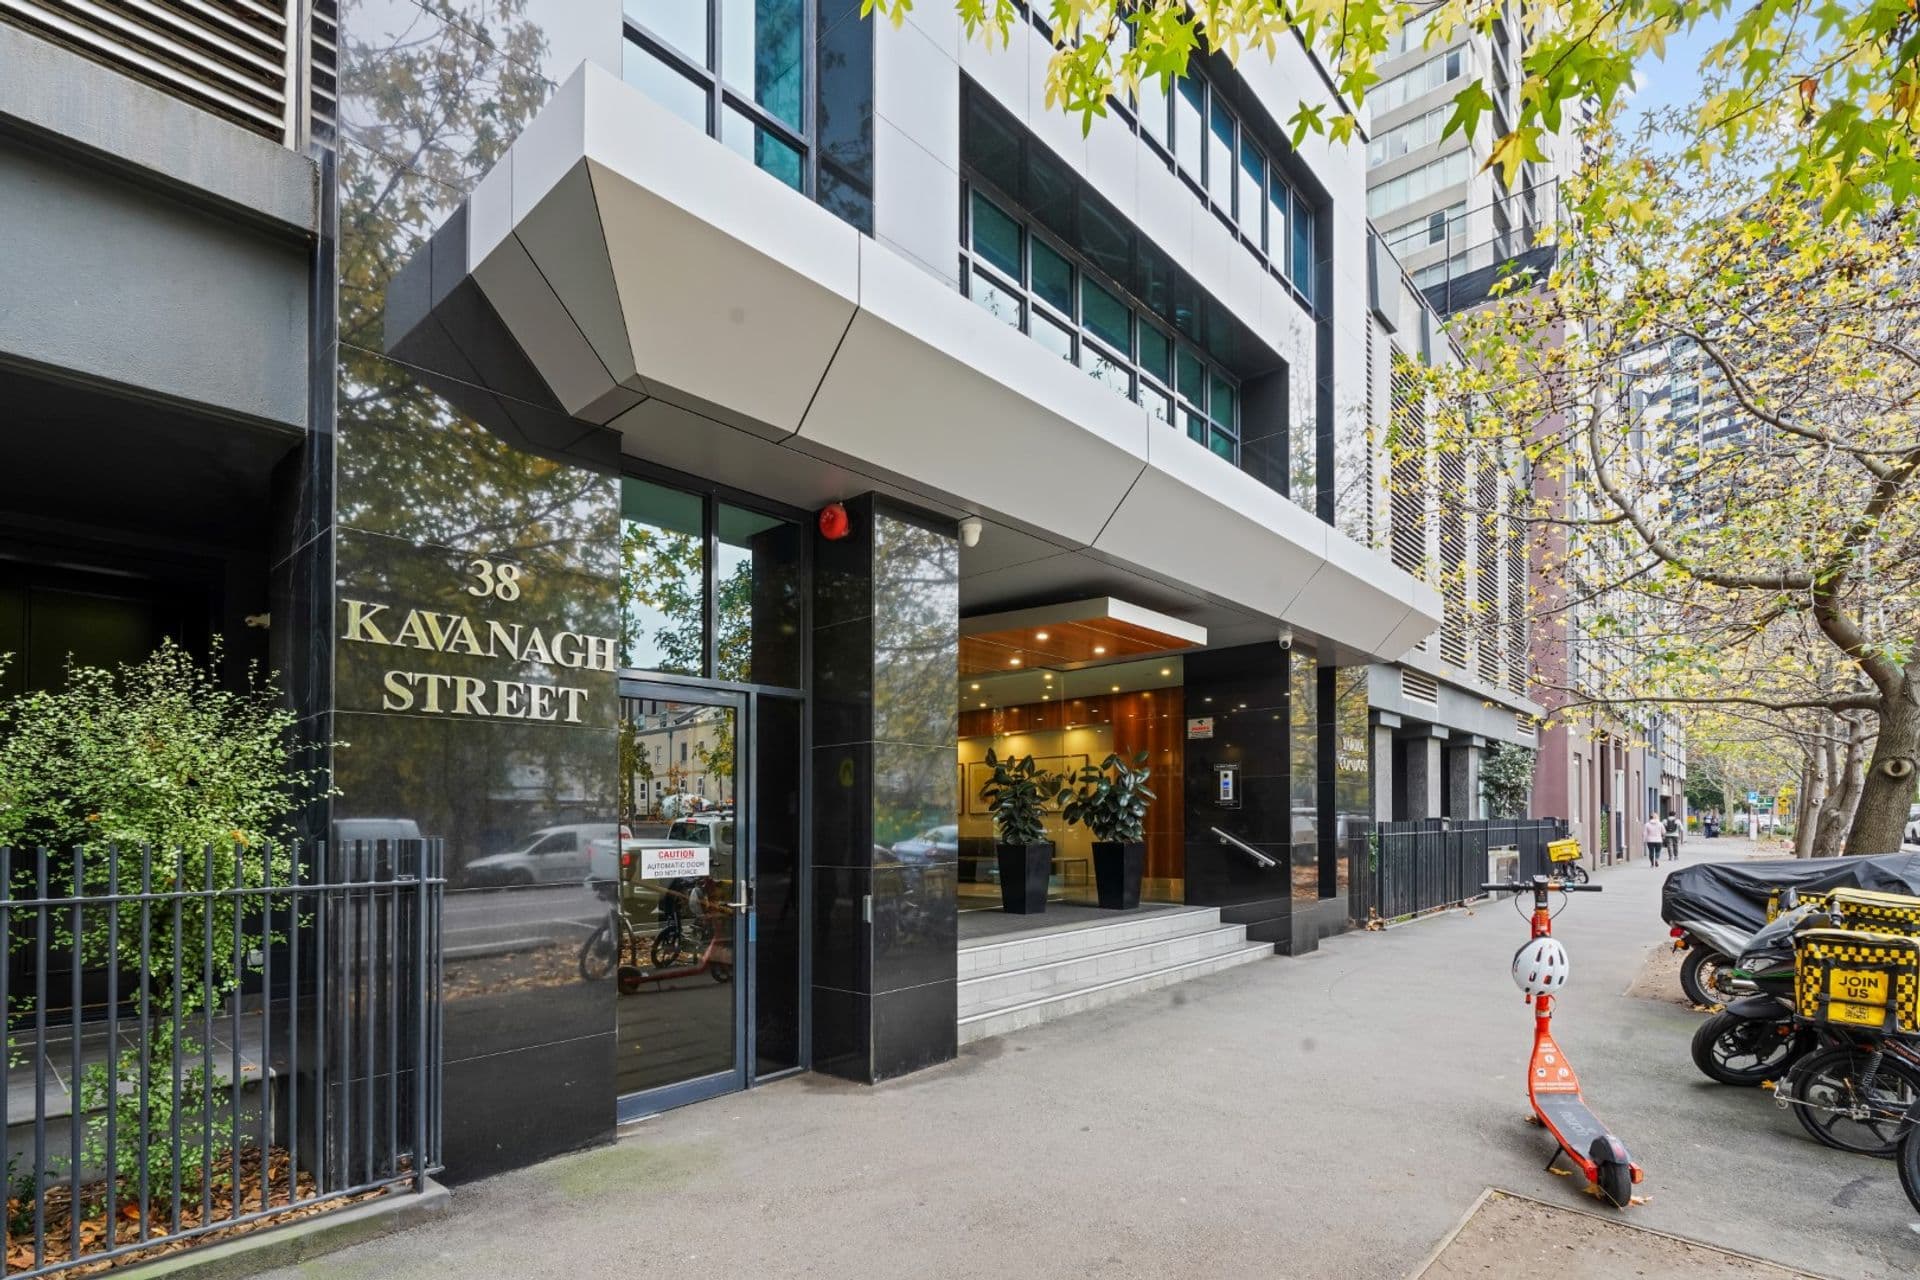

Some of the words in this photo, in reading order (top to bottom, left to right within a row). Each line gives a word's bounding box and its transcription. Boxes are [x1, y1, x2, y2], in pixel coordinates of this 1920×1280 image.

[468, 559, 521, 602] 38
[341, 598, 618, 672] KAVANAGH
[383, 670, 588, 723] STREET
[658, 850, 694, 859] CAUTION
[647, 862, 685, 870] AUTOMATIC
[686, 861, 705, 869] DOOR
[1839, 976, 1879, 988] JOIN
[1847, 988, 1869, 999] US
